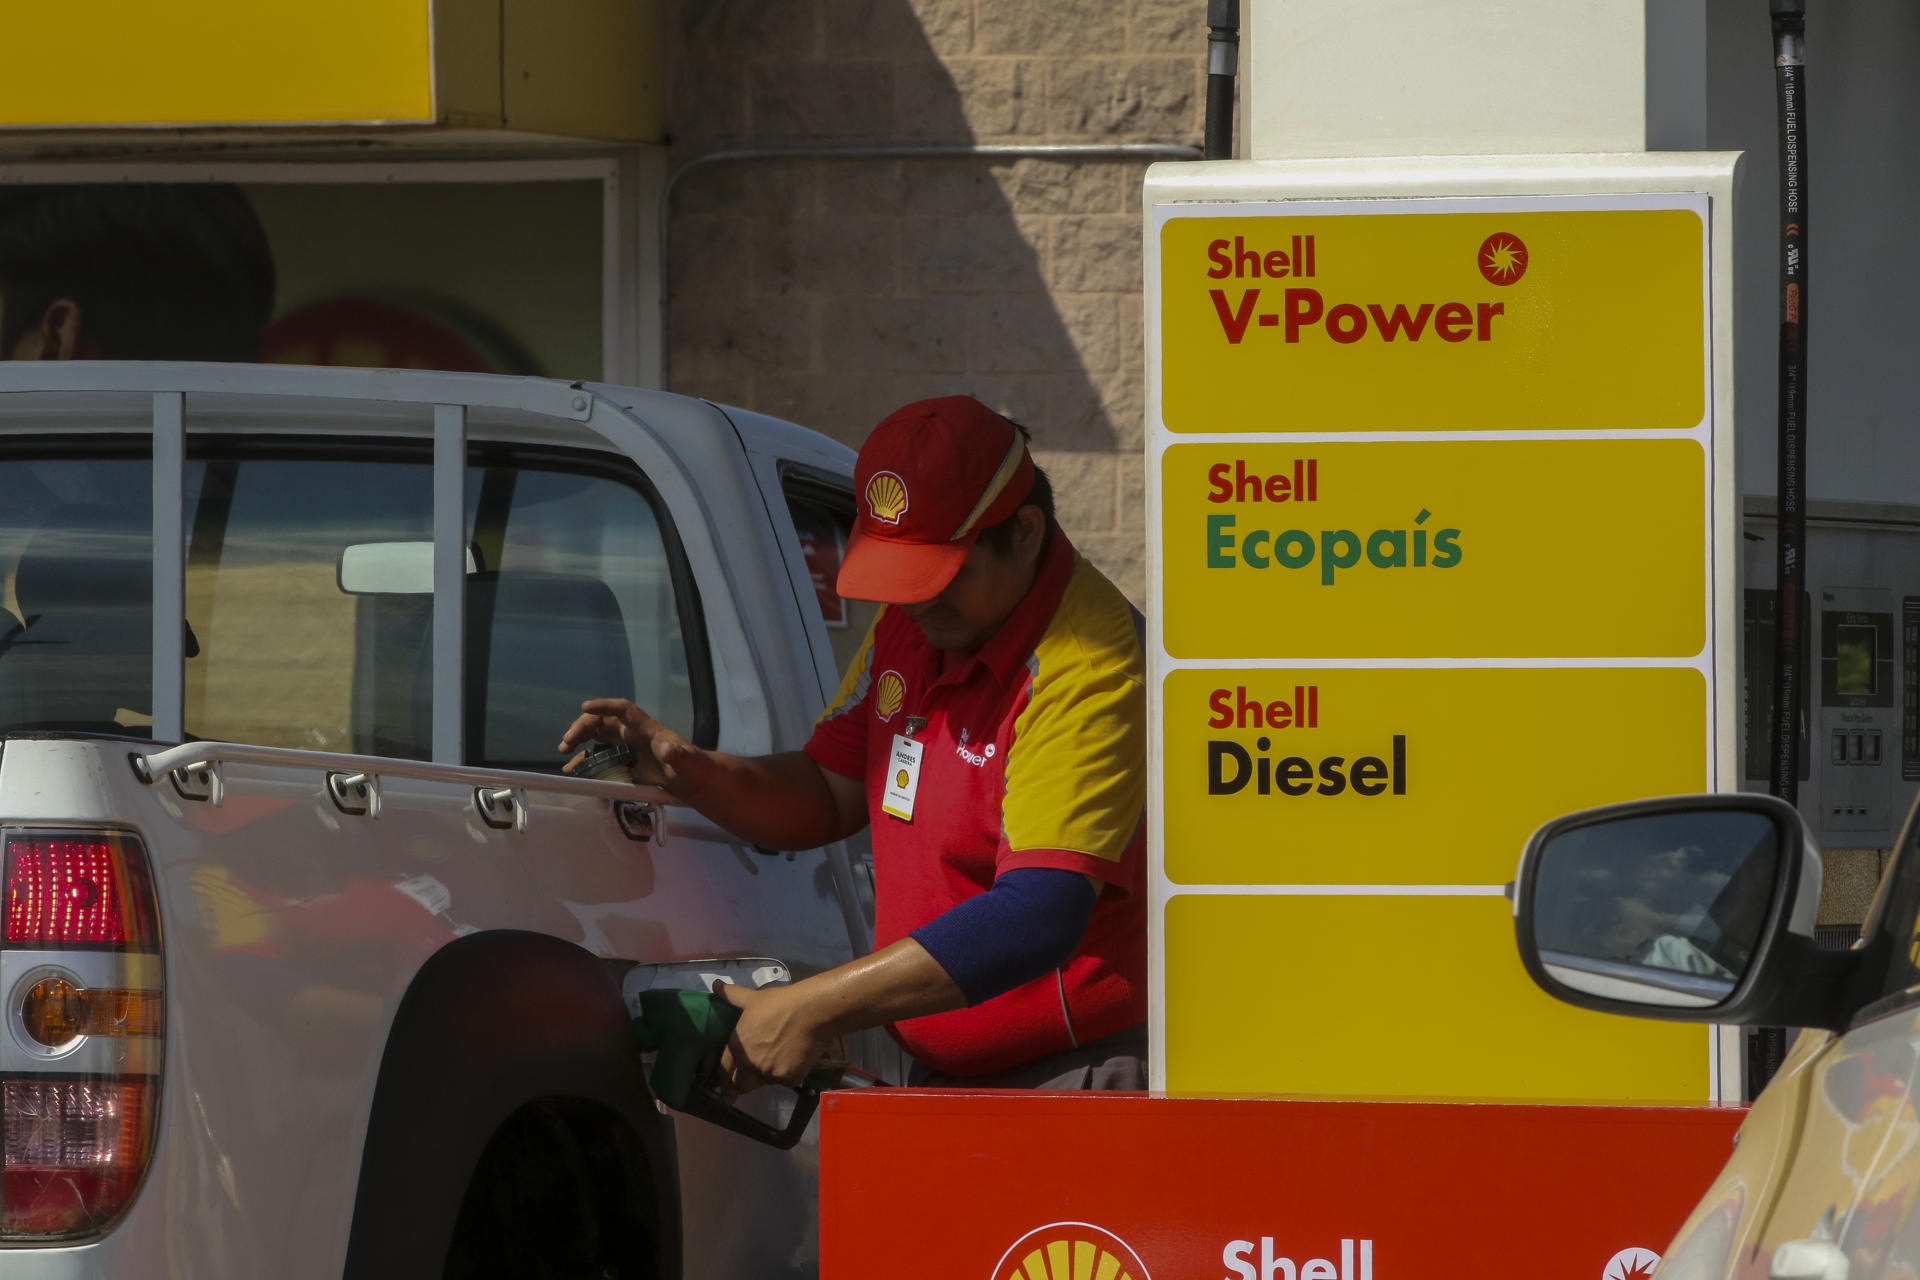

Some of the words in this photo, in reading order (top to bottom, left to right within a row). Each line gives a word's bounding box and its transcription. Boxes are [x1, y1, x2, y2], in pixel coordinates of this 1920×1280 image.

[1786, 112, 1797, 134] FUEL
[1787, 135, 1798, 187] DISPENSING
[1788, 188, 1799, 213] HOSE
[1208, 235, 1315, 279] Shell
[1209, 288, 1504, 344] V-Power
[1786, 411, 1796, 433] FUEL
[1208, 459, 1317, 503] Shell
[1785, 434, 1796, 487] DISPENSING
[1785, 488, 1796, 513] HOSE
[1207, 509, 1462, 585] Ecopaís
[1208, 686, 1317, 729] Shell
[1781, 711, 1791, 734] FUEL
[1208, 735, 1406, 796] Diesel
[1779, 735, 1790, 785] DISPENSING
